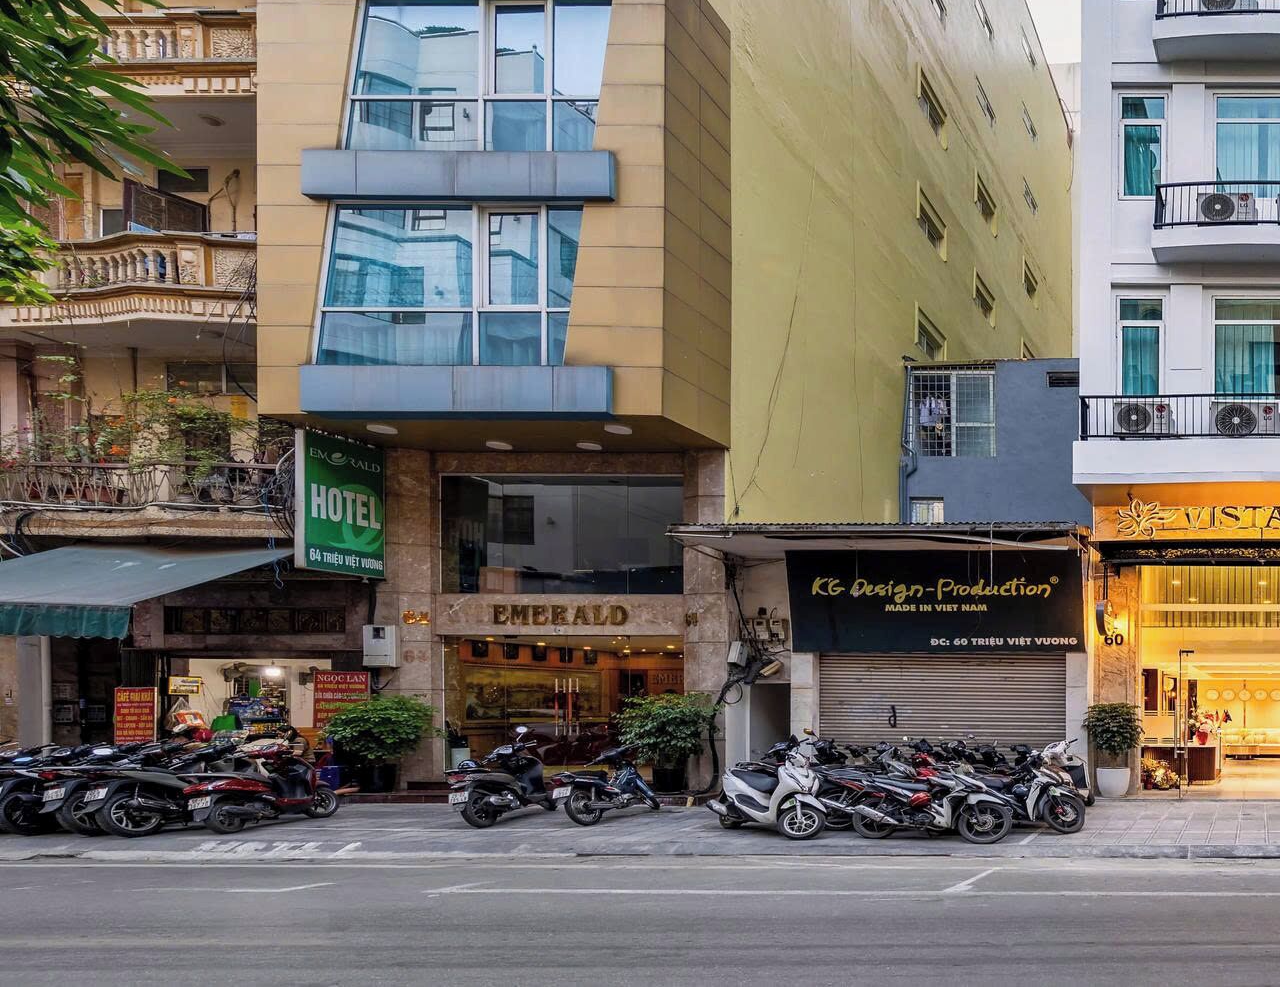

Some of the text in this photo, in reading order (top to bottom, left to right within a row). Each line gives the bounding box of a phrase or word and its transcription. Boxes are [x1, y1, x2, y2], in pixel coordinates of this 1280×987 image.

[311, 483, 382, 530] HOTEL
[310, 548, 383, 570] 64 TRIỆU VIỆT VƯƠNG
[885, 604, 988, 612] MADE IN VIET NAM
[493, 604, 629, 626] EMERALD
[930, 637, 1078, 649] ĐC: 60 TRIỆU VIỆT VƯƠNG
[1104, 633, 1124, 646] 60
[317, 675, 345, 683] NGỌC
